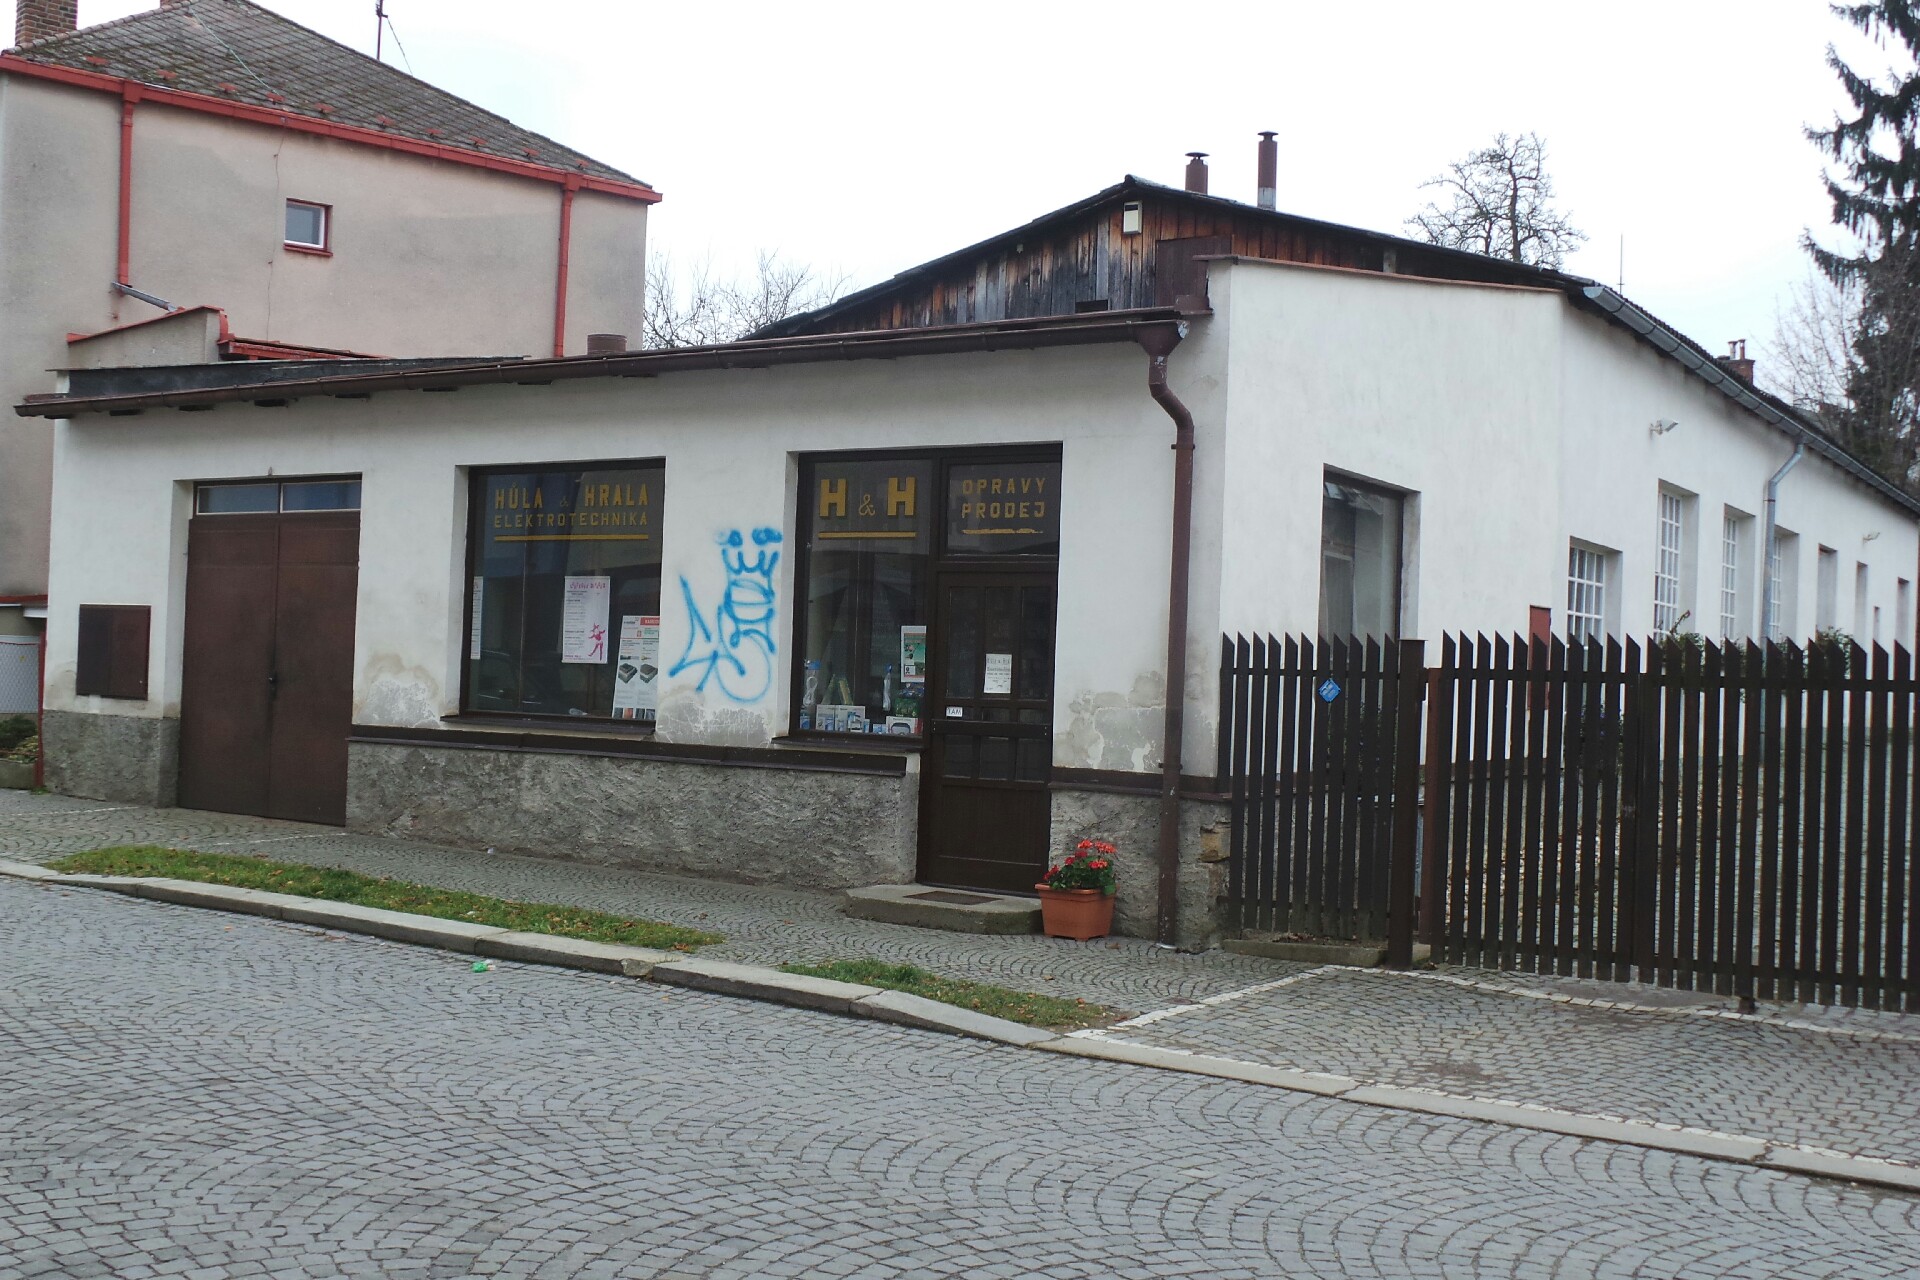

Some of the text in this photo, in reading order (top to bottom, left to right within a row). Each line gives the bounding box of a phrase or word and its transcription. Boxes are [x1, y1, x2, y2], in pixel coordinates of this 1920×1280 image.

[962, 477, 1046, 495] OPRAVY
[495, 482, 543, 509] HŮLA
[584, 483, 649, 507] HRALA
[820, 476, 915, 517] H & H
[961, 501, 1045, 519] PRODEJ
[494, 511, 648, 528] ELEKTROTECHNIKA
